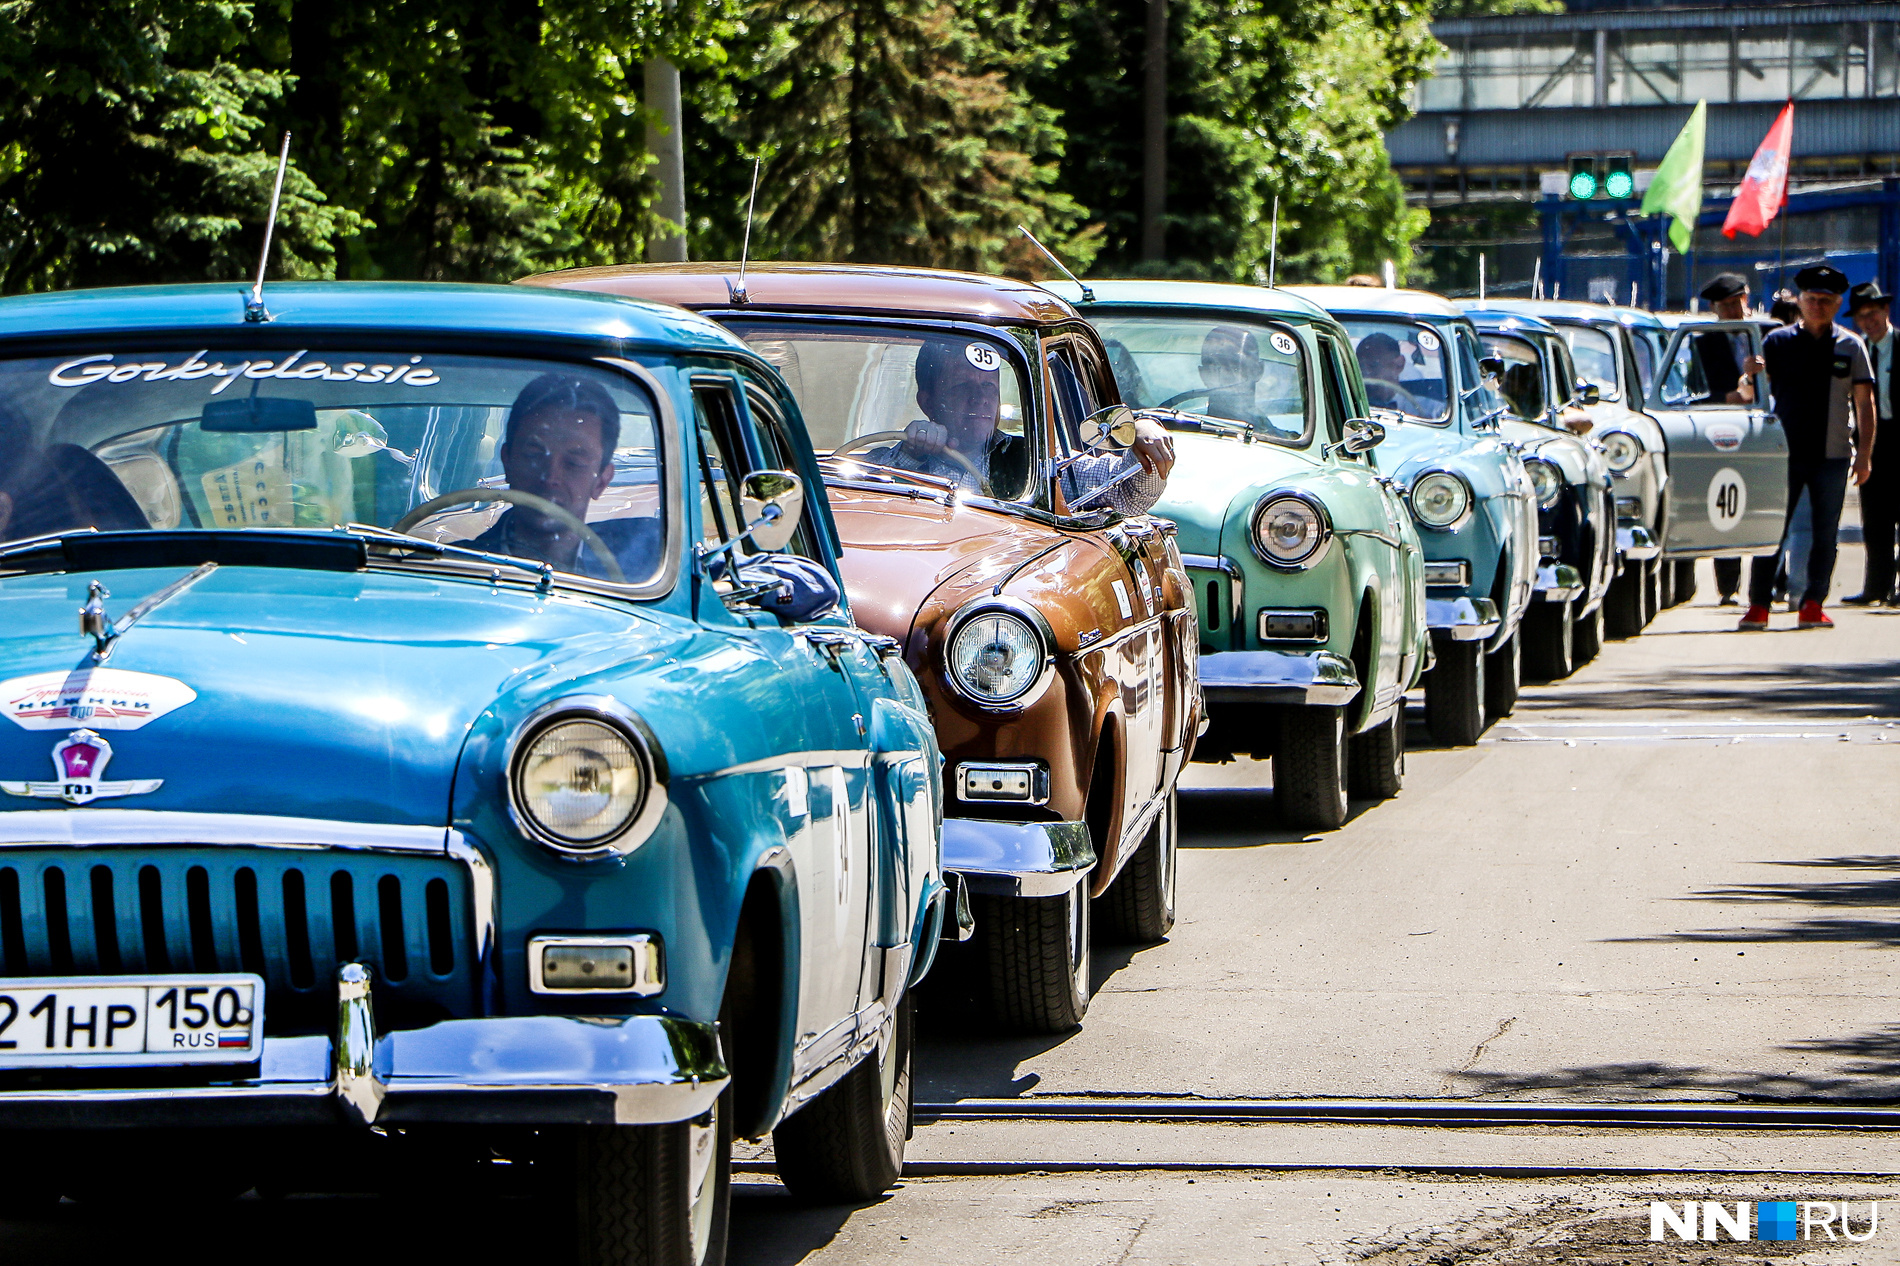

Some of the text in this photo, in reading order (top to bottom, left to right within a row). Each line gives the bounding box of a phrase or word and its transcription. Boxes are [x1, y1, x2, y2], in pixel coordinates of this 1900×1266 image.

[973, 347, 992, 364] 35
[1276, 336, 1290, 351] 36
[49, 349, 441, 395] Gorkyclassic
[1716, 483, 1738, 518] 40
[156, 986, 241, 1030] 150
[173, 1032, 216, 1048] RUS
